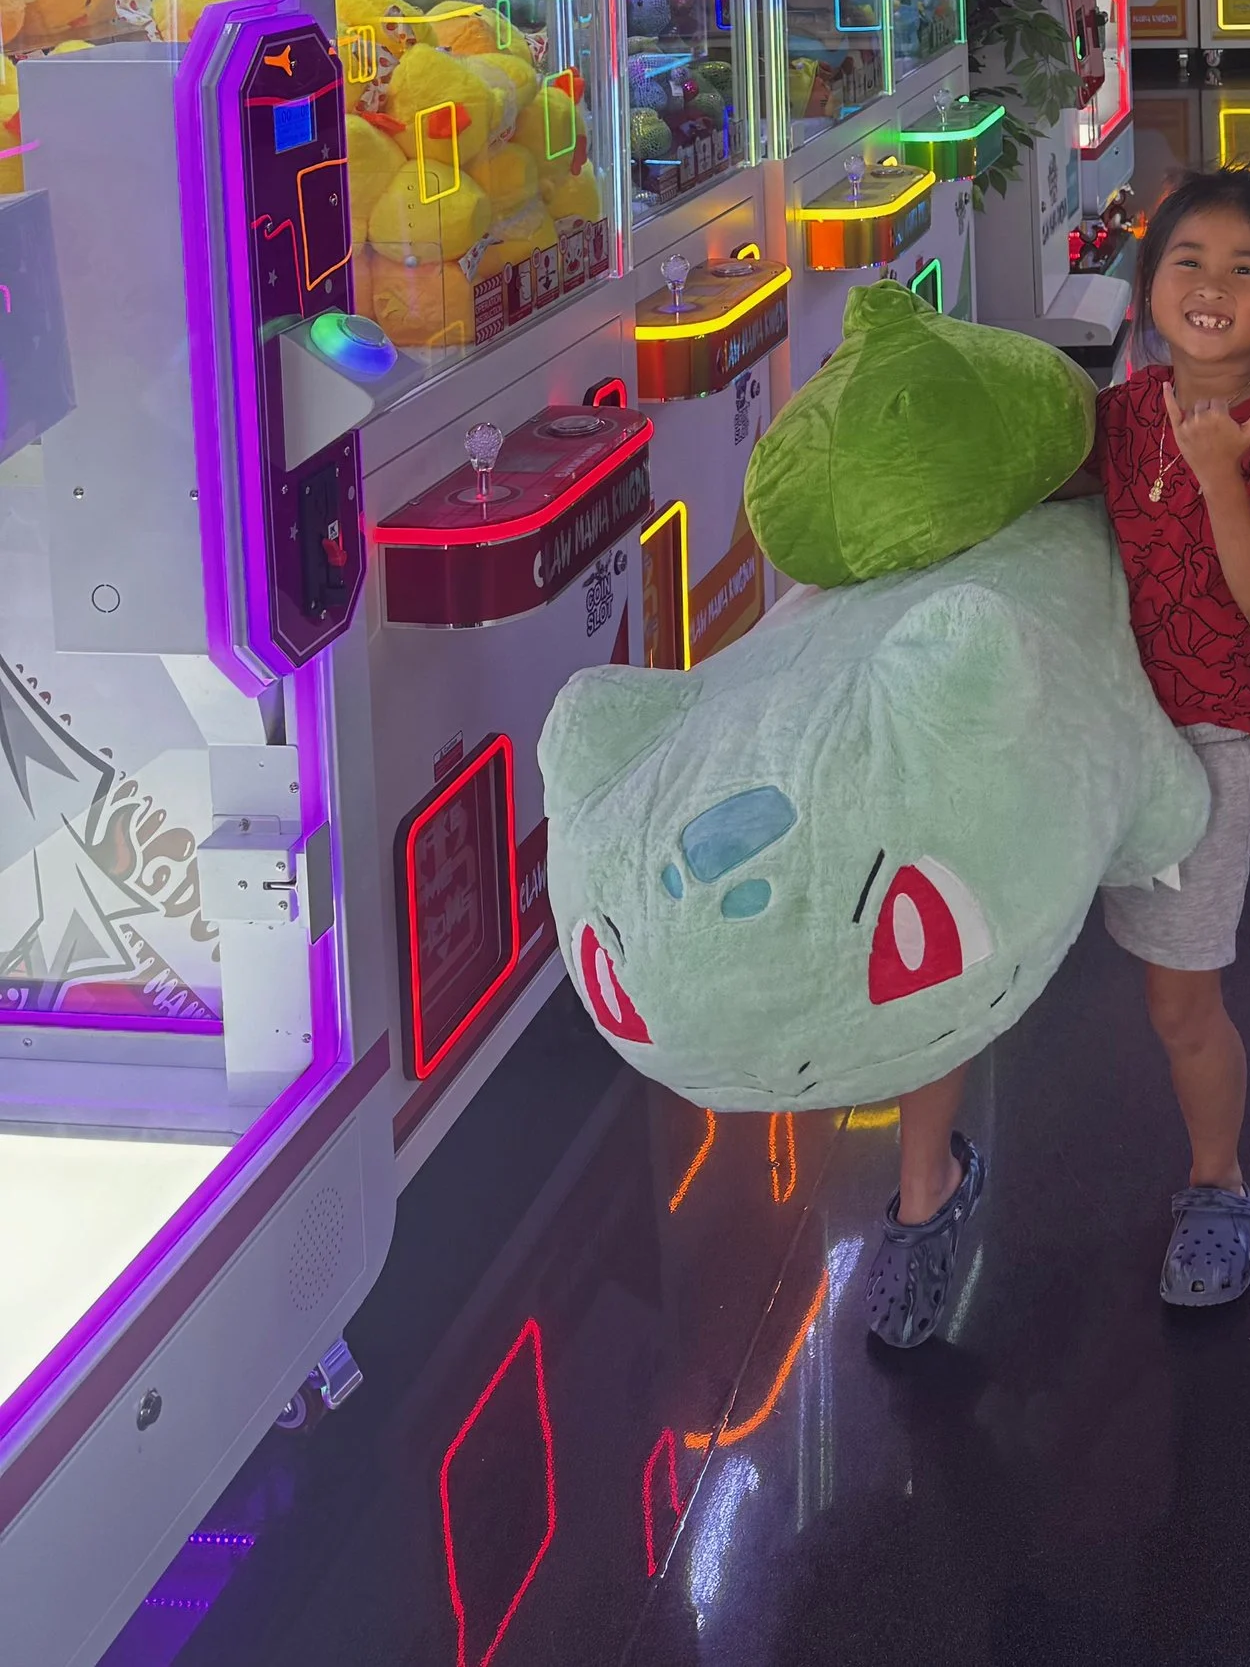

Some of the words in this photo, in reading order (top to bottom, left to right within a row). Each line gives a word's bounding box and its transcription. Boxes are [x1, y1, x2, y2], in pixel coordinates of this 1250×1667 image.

[575, 496, 611, 555] MANIA
[586, 571, 612, 613] COIN
[586, 593, 614, 637] SLOT
